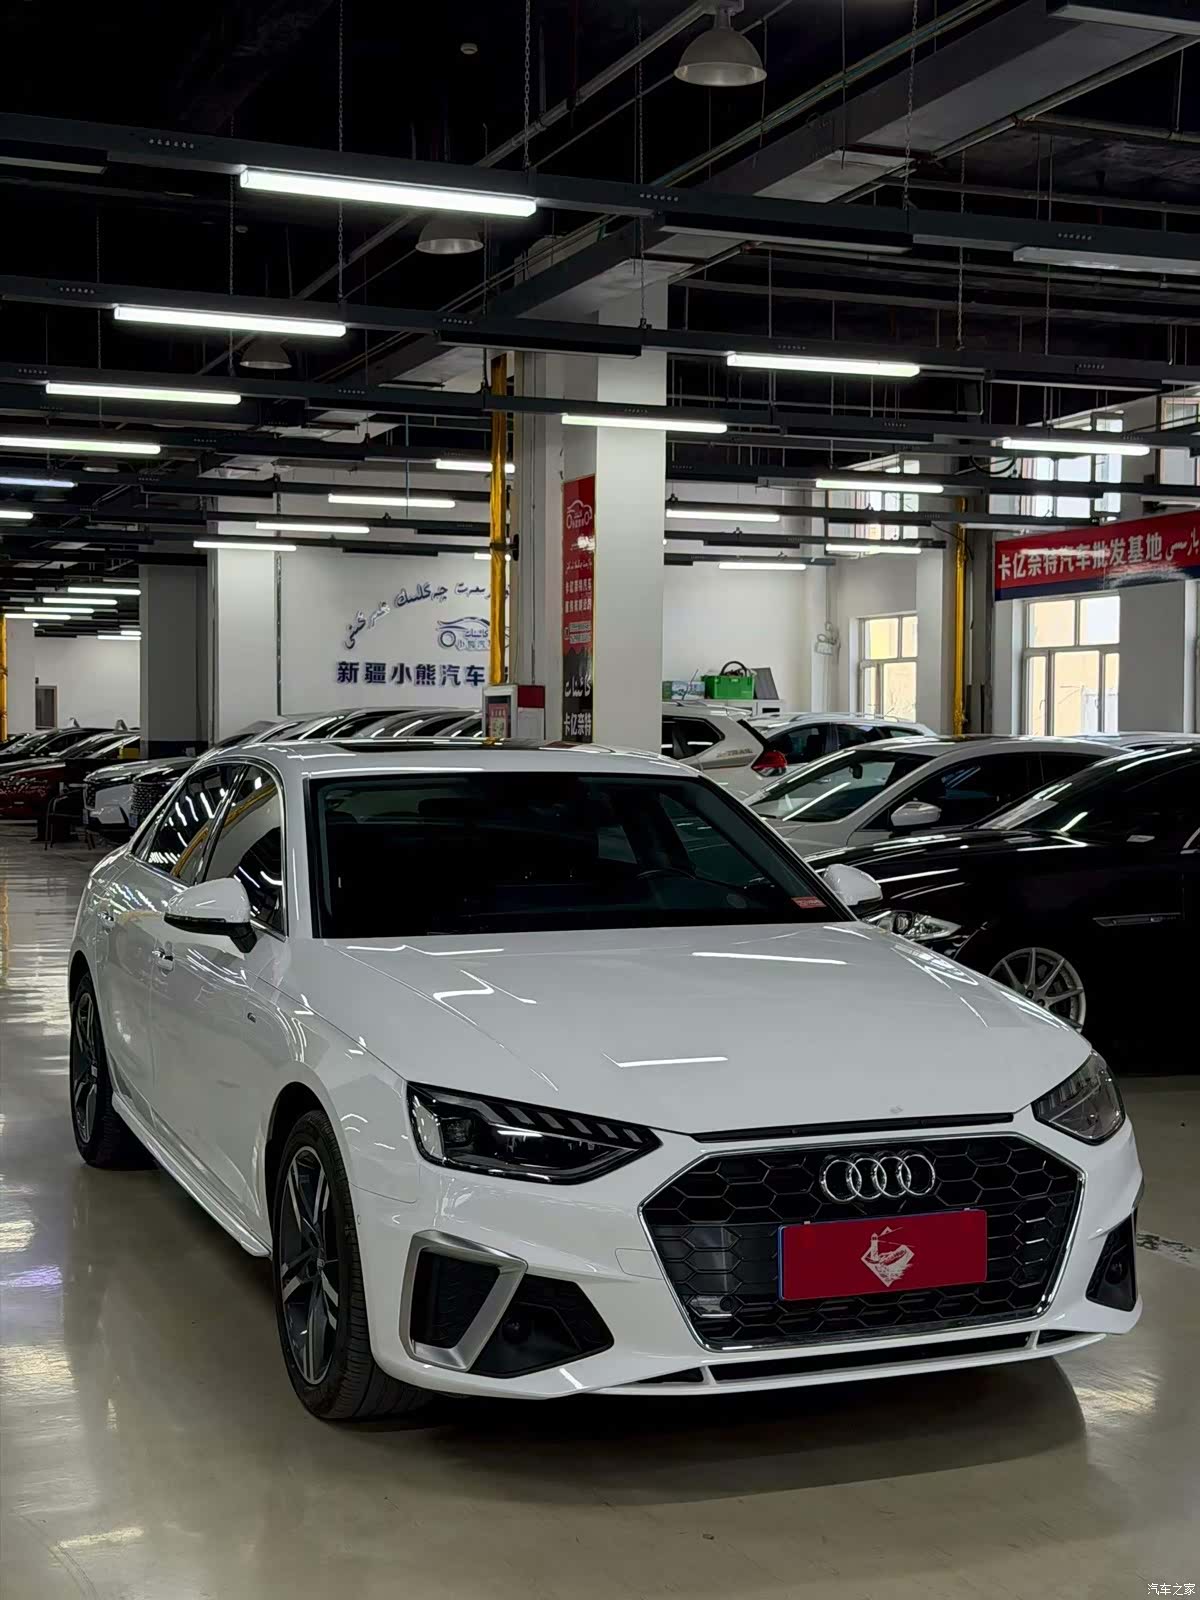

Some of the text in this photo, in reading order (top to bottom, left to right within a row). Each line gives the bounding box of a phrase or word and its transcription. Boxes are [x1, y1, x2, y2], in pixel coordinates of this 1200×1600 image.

[998, 532, 1163, 581] 卡亿奈特汽车批发基地
[337, 661, 508, 687] 新疆小熊汽车
[564, 712, 592, 736] 卡亿奈特
